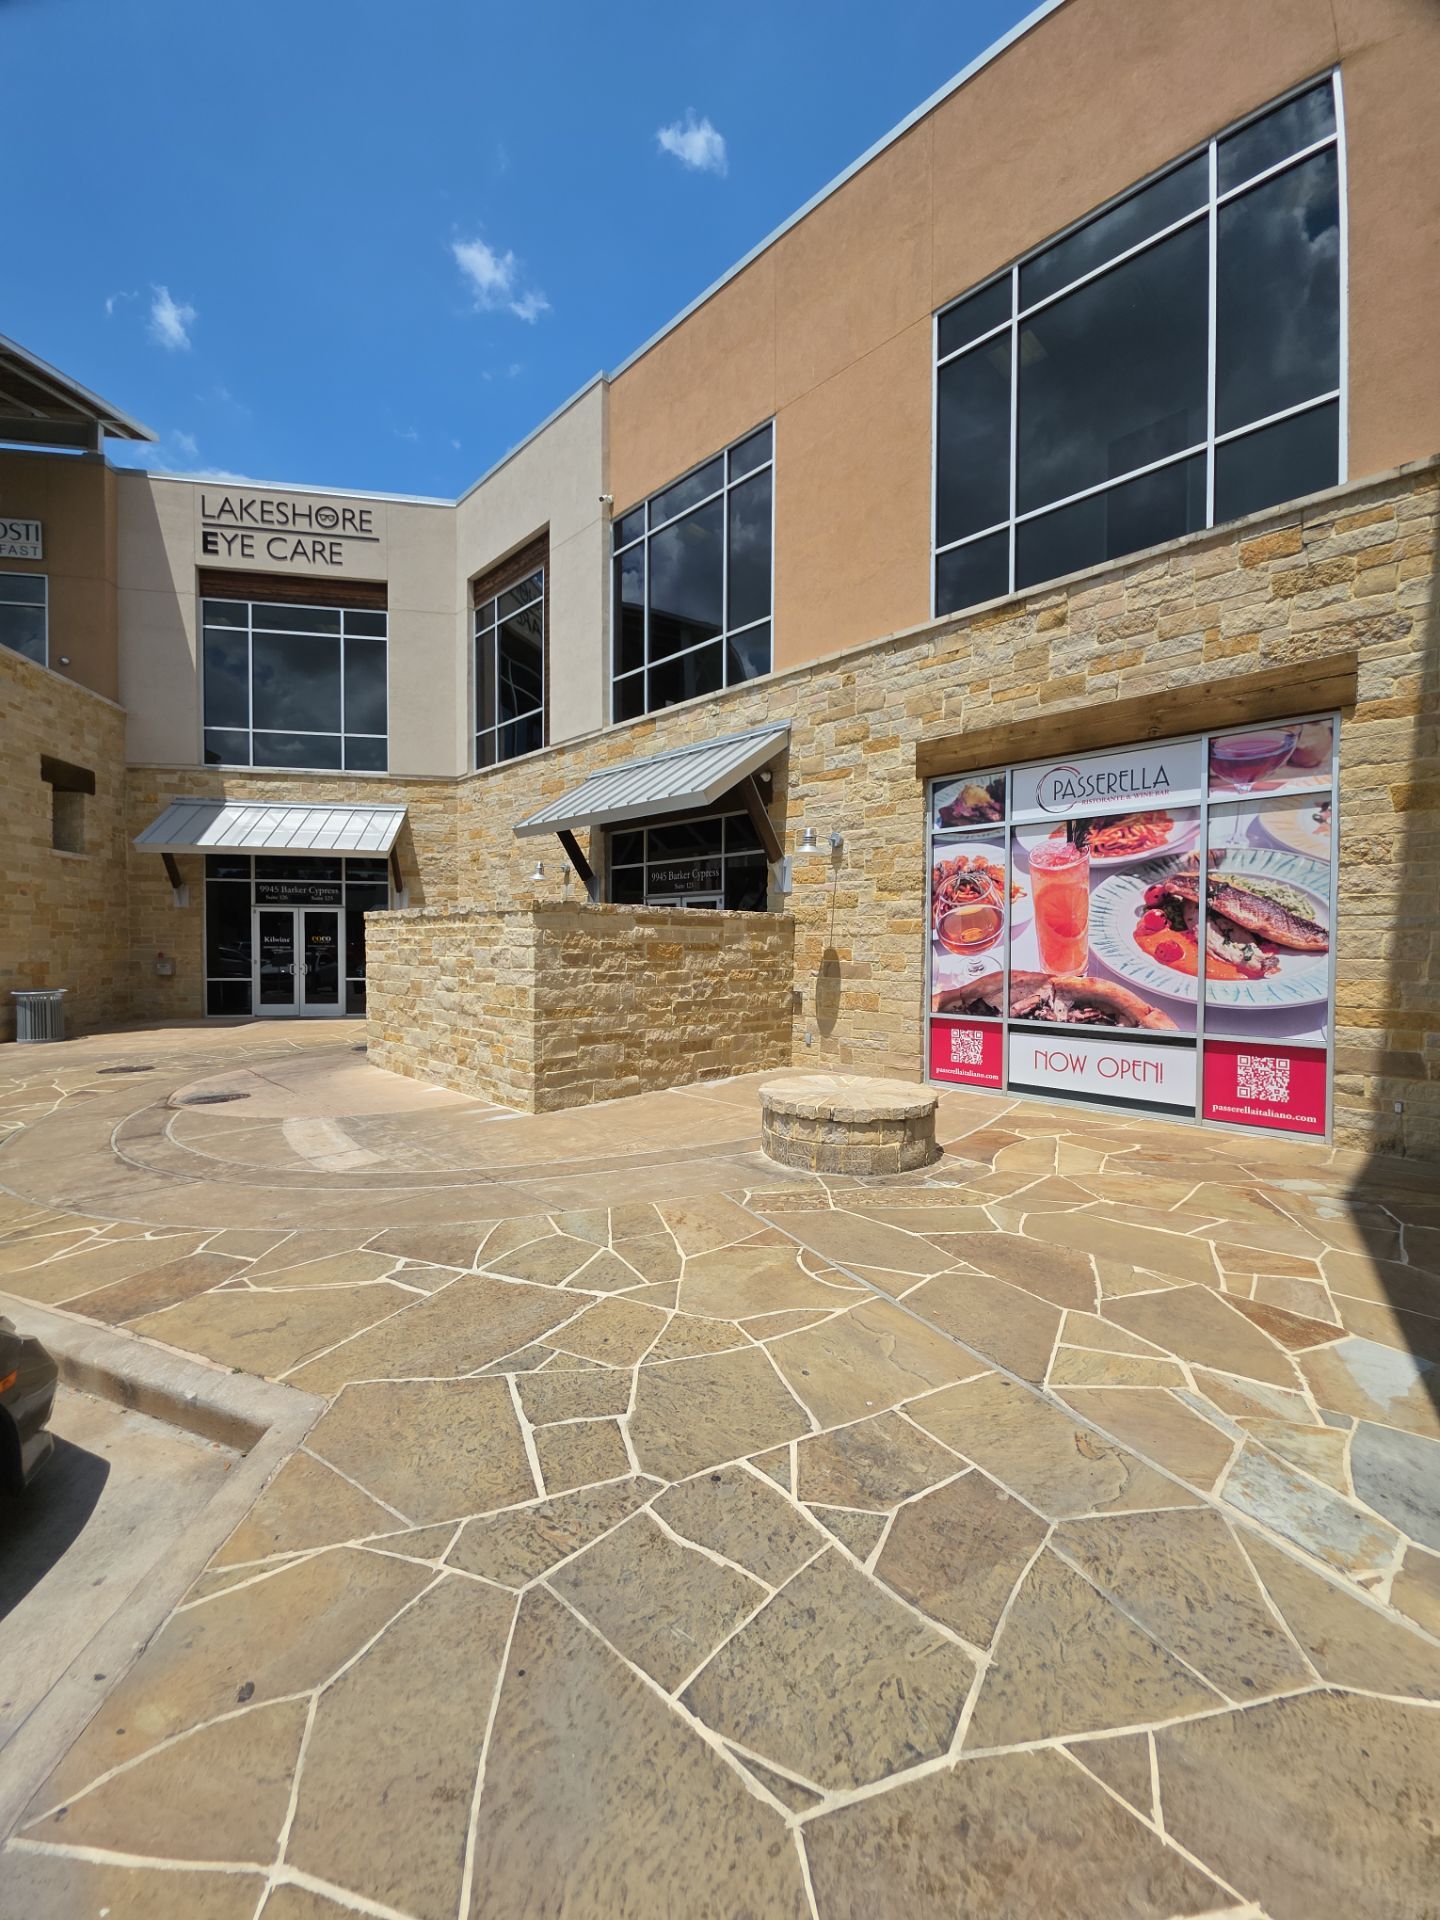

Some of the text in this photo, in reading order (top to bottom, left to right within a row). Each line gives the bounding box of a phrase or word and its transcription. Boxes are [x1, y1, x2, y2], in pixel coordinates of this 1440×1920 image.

[201, 494, 373, 533] LAKESHORE
[202, 530, 343, 566] EYE CARE
[1053, 765, 1170, 801] PASSERELLA
[1081, 794, 1123, 805] RISTORANTE
[651, 868, 720, 881] 9945 Barker Cypress
[259, 885, 339, 896] 9945 Barker Cypress
[936, 1067, 999, 1080] passerellaitaliano.com
[1034, 1050, 1163, 1084] NOW OPEN!
[1212, 1104, 1317, 1123] passerellaitaliano.com
